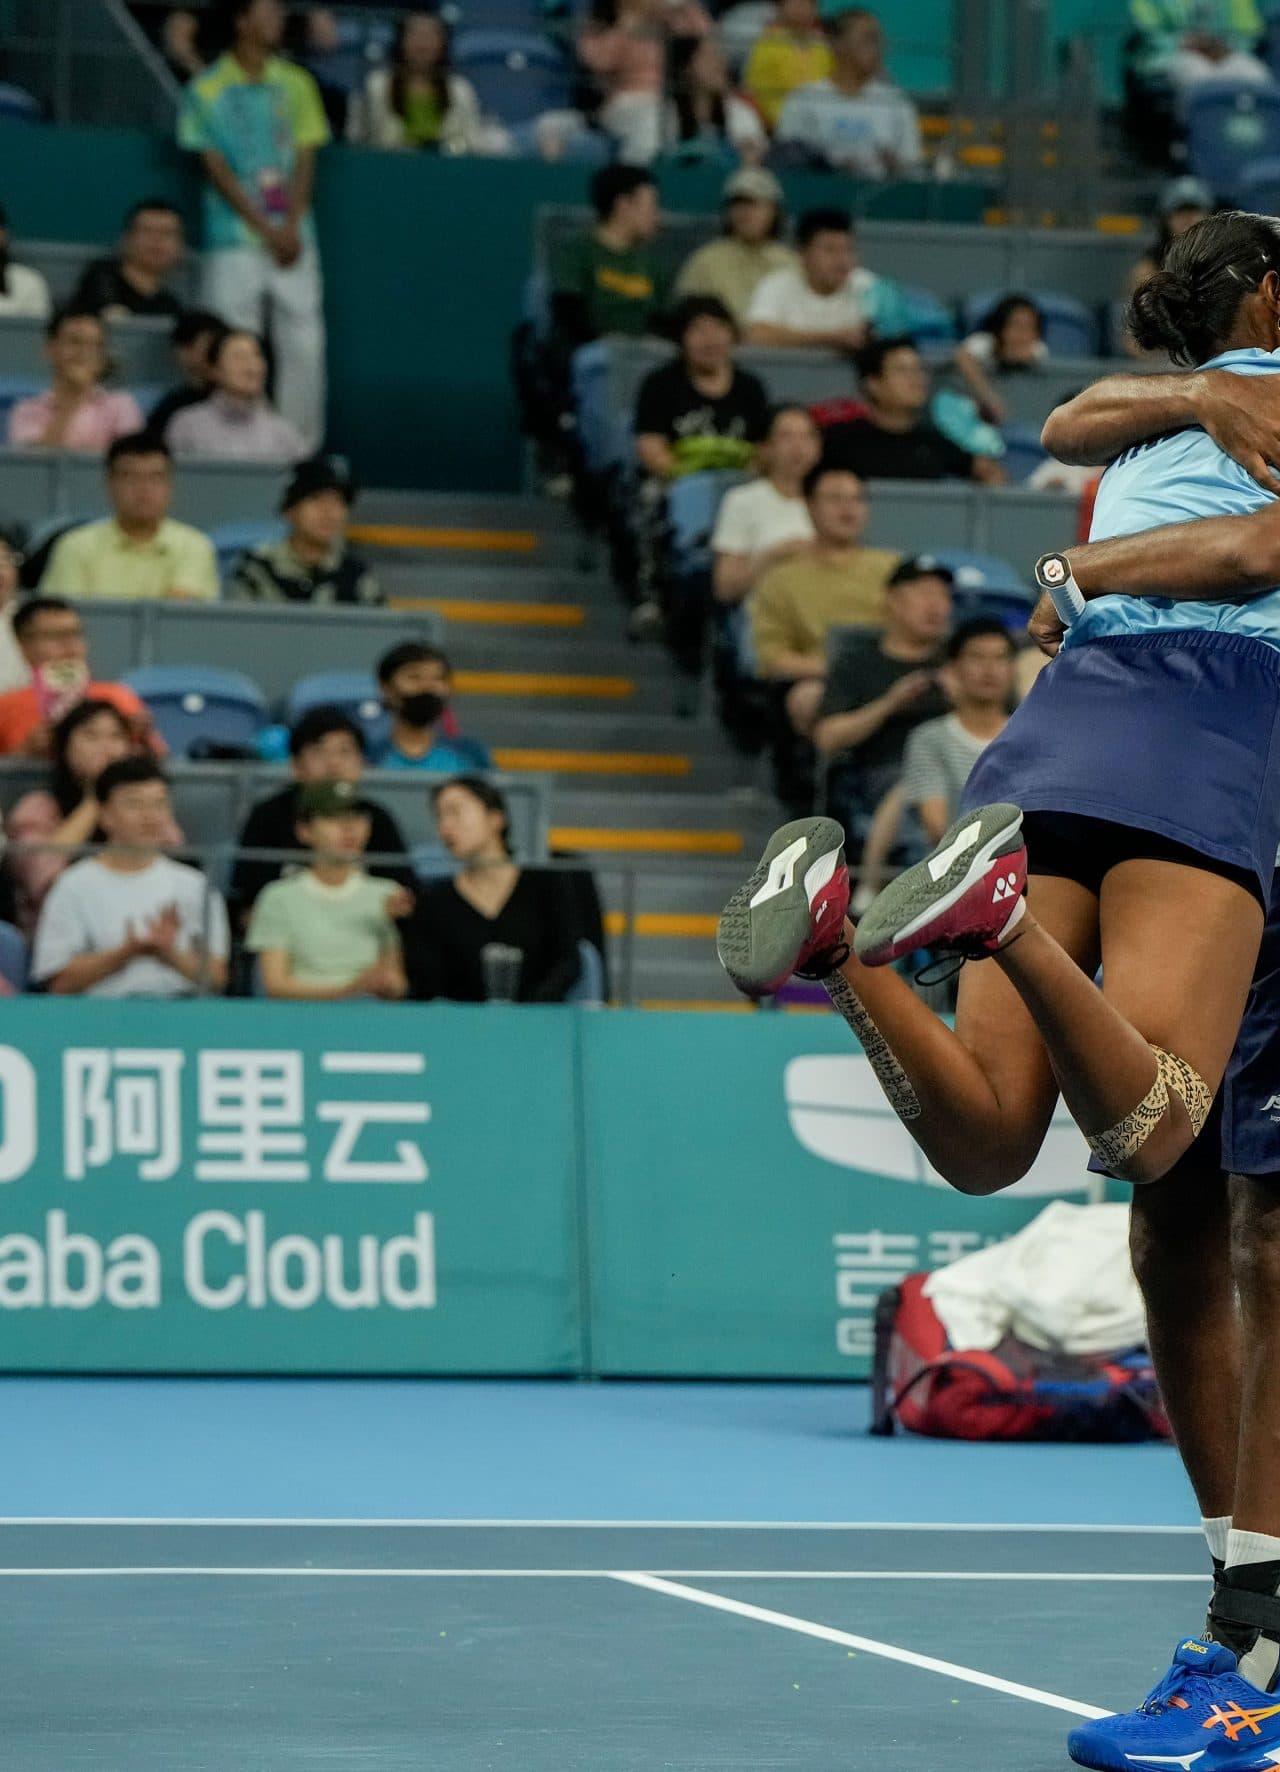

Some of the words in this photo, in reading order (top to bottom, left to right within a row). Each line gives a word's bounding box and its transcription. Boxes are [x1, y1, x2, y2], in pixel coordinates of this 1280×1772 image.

[62, 1047, 432, 1184] 阿里云
[183, 1209, 437, 1310] Cloud
